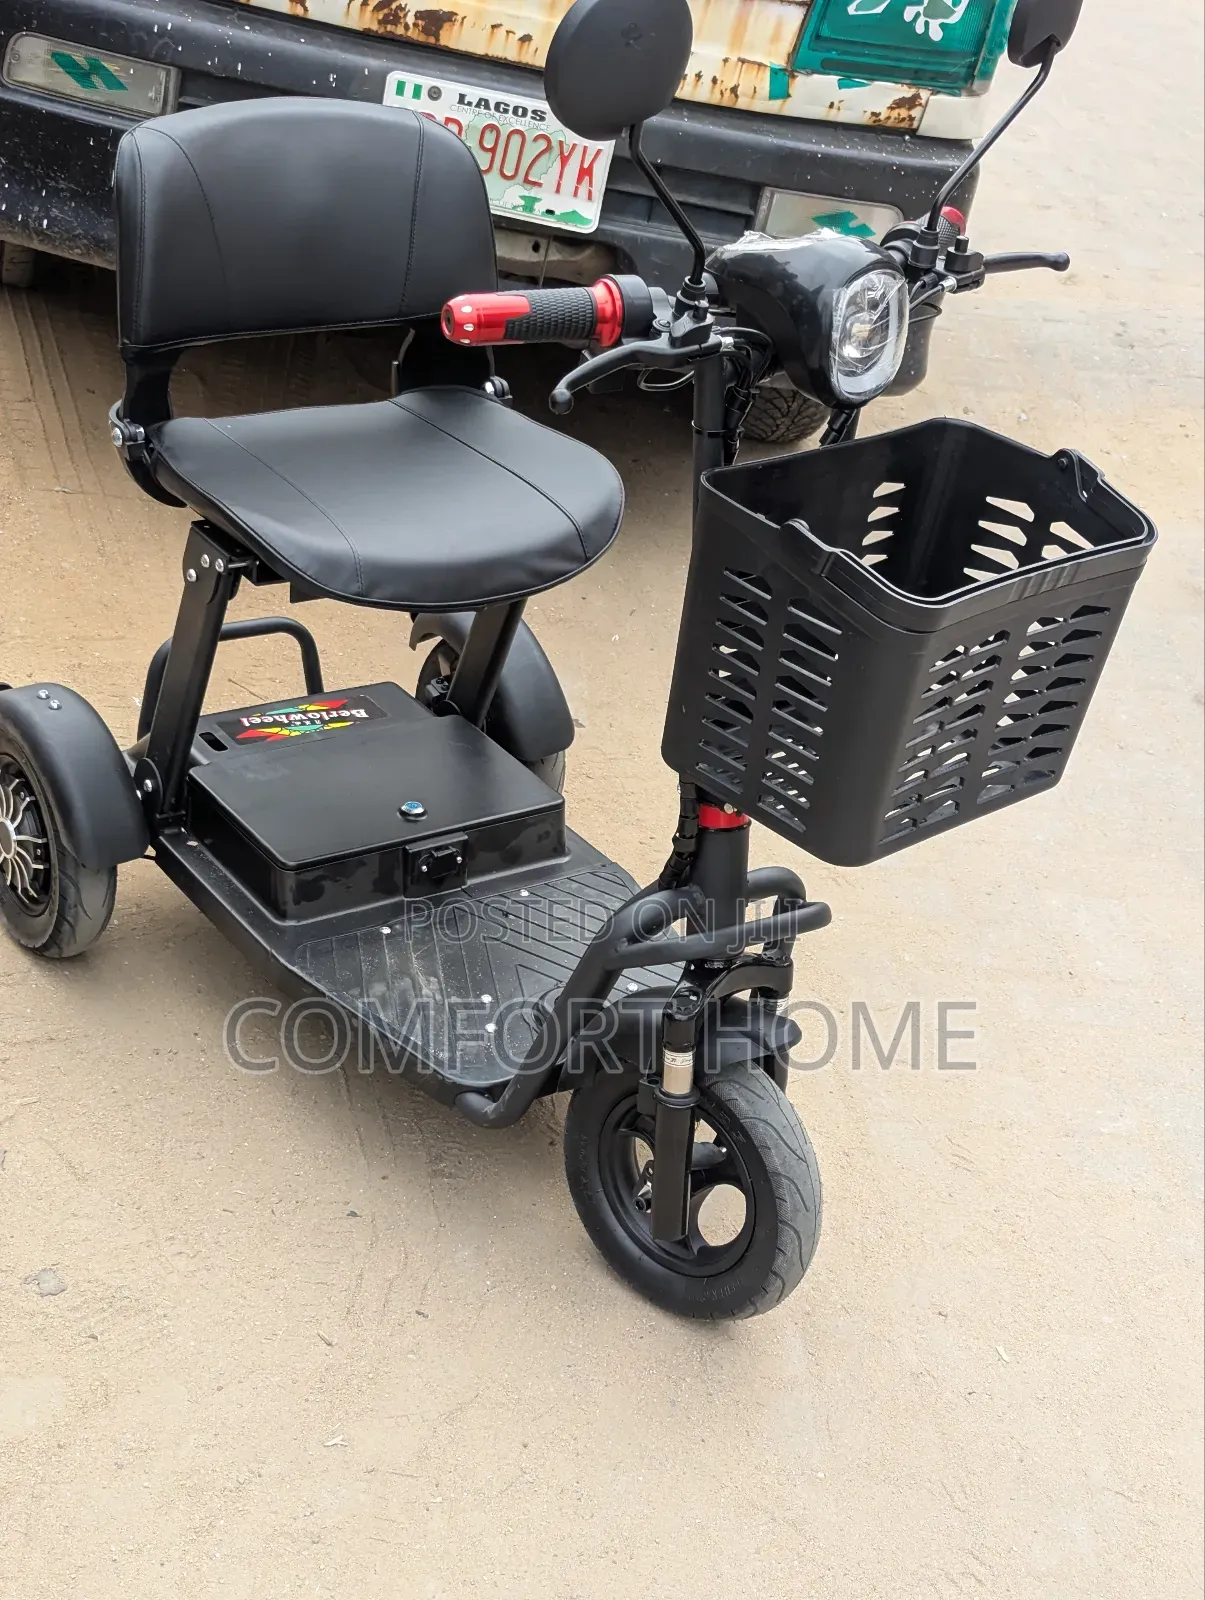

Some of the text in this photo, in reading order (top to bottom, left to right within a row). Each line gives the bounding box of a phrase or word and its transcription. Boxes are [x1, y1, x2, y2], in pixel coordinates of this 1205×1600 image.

[450, 104, 552, 131] CENTRE OF EXCELLENCE
[457, 93, 547, 122] LAGOS
[239, 708, 369, 727] Berlowheel
